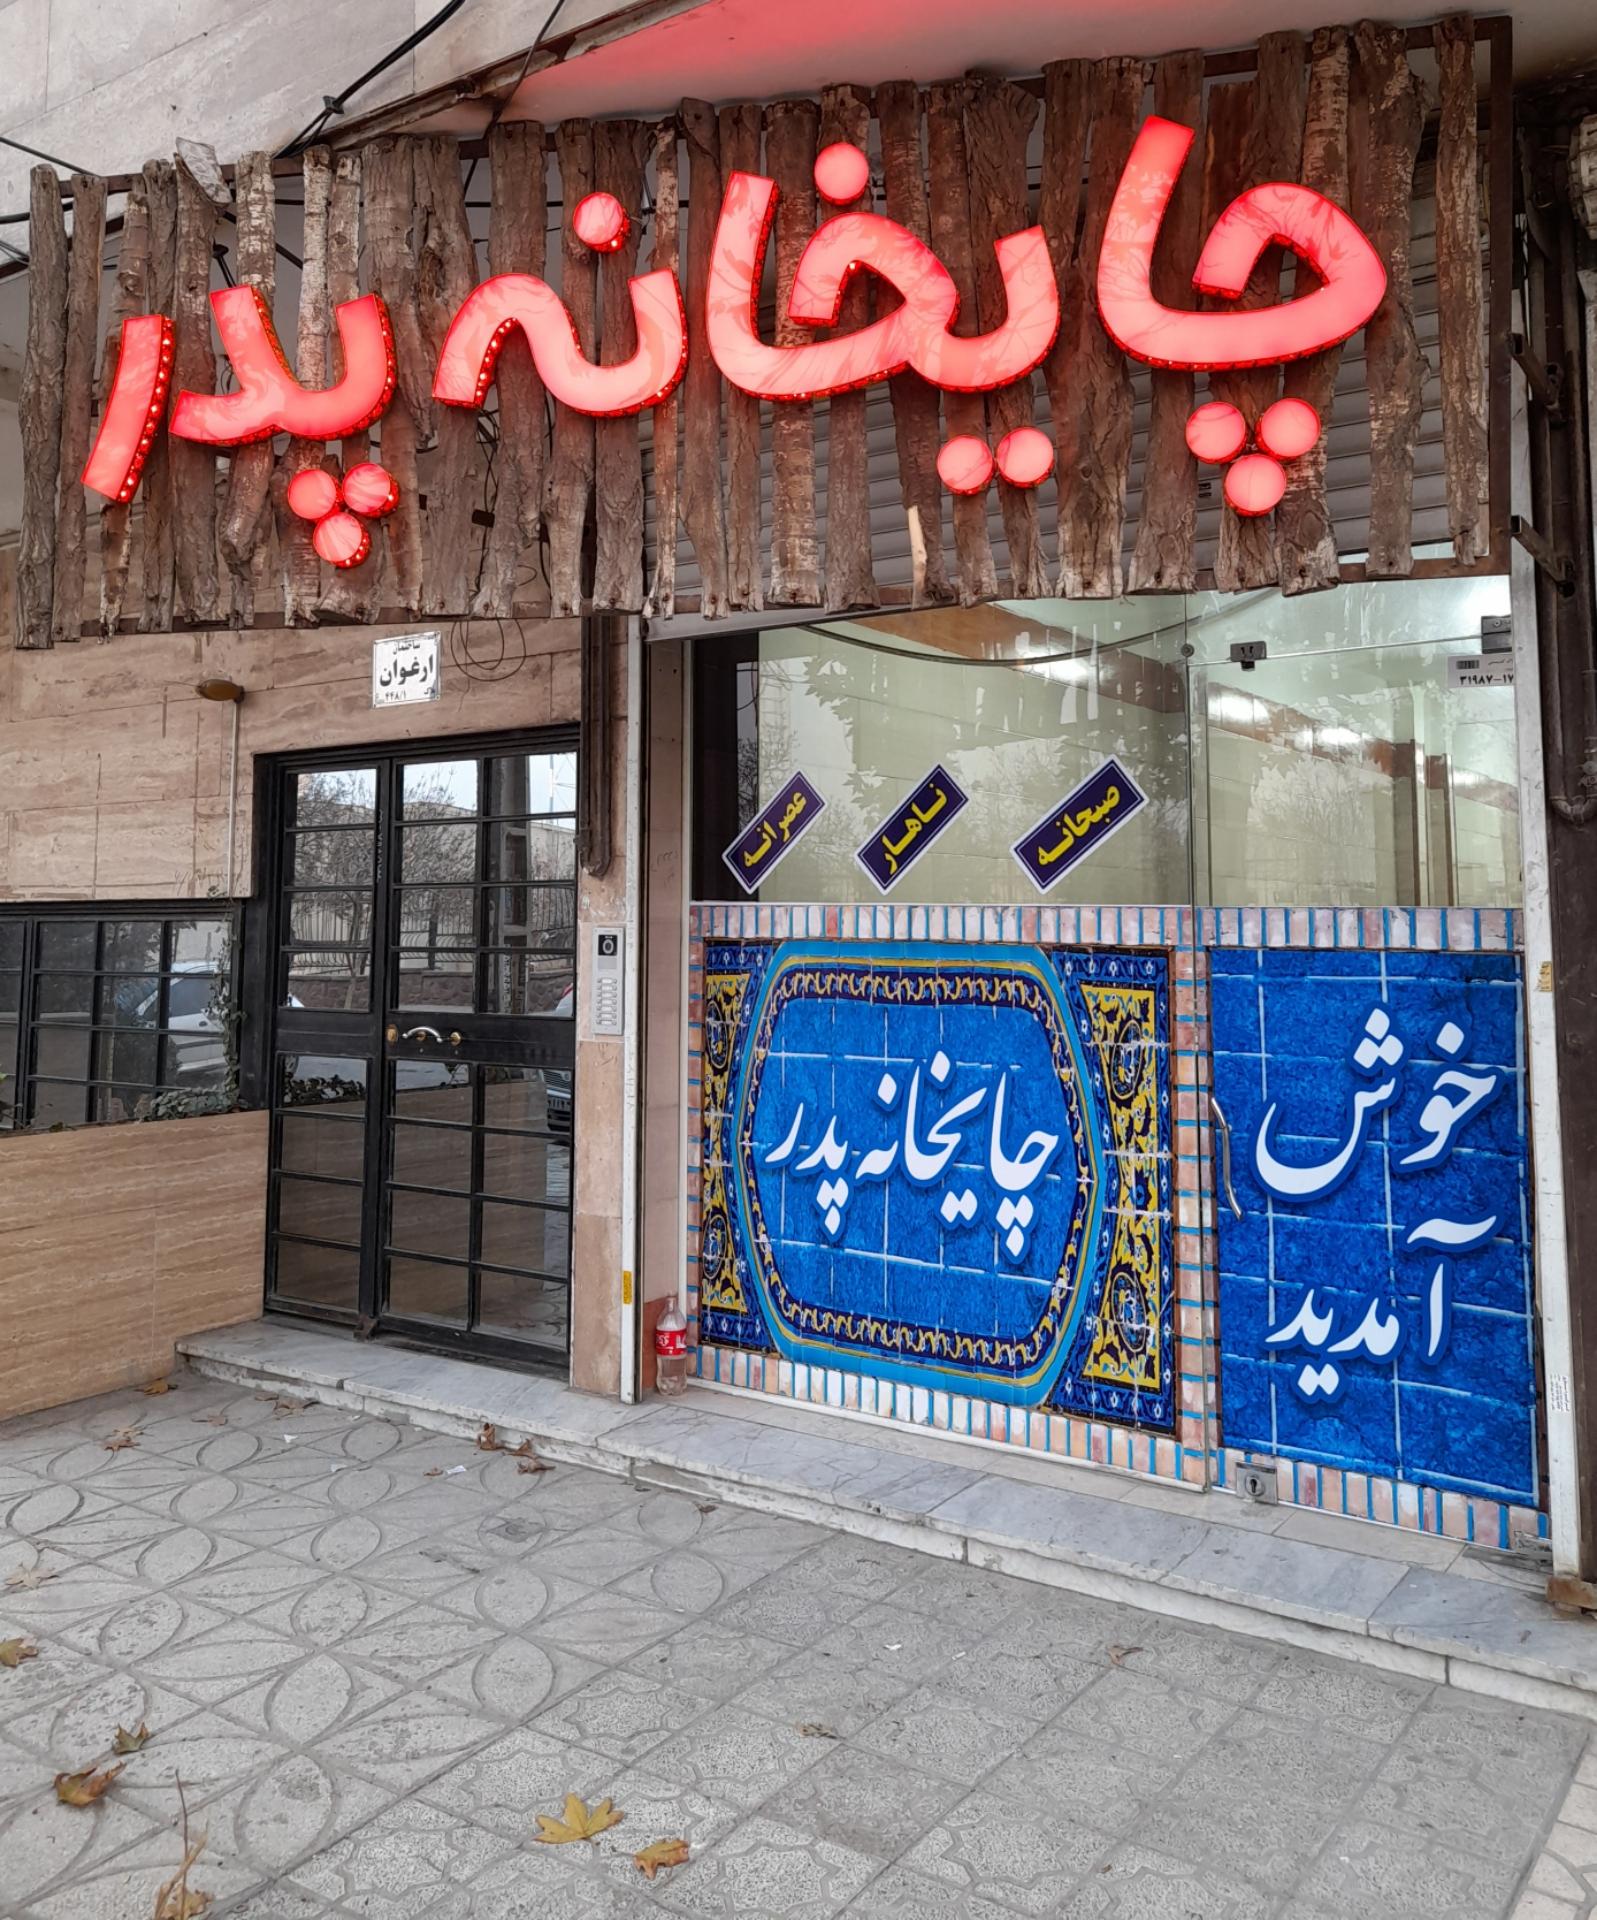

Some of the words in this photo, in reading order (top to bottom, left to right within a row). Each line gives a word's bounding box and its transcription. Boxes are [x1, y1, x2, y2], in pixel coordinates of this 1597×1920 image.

[433, 115, 1388, 517] چایخانه
[81, 283, 399, 569] پدر
[379, 653, 434, 687] ارغوان
[742, 790, 808, 869] عصرانه
[883, 783, 948, 875] ناهار
[1038, 783, 1121, 867] صبحانه
[765, 1102, 849, 1236] پدر
[855, 1050, 1060, 1257] چایخانه
[1255, 1007, 1498, 1195] خوش
[1264, 1215, 1498, 1396] آمدید
